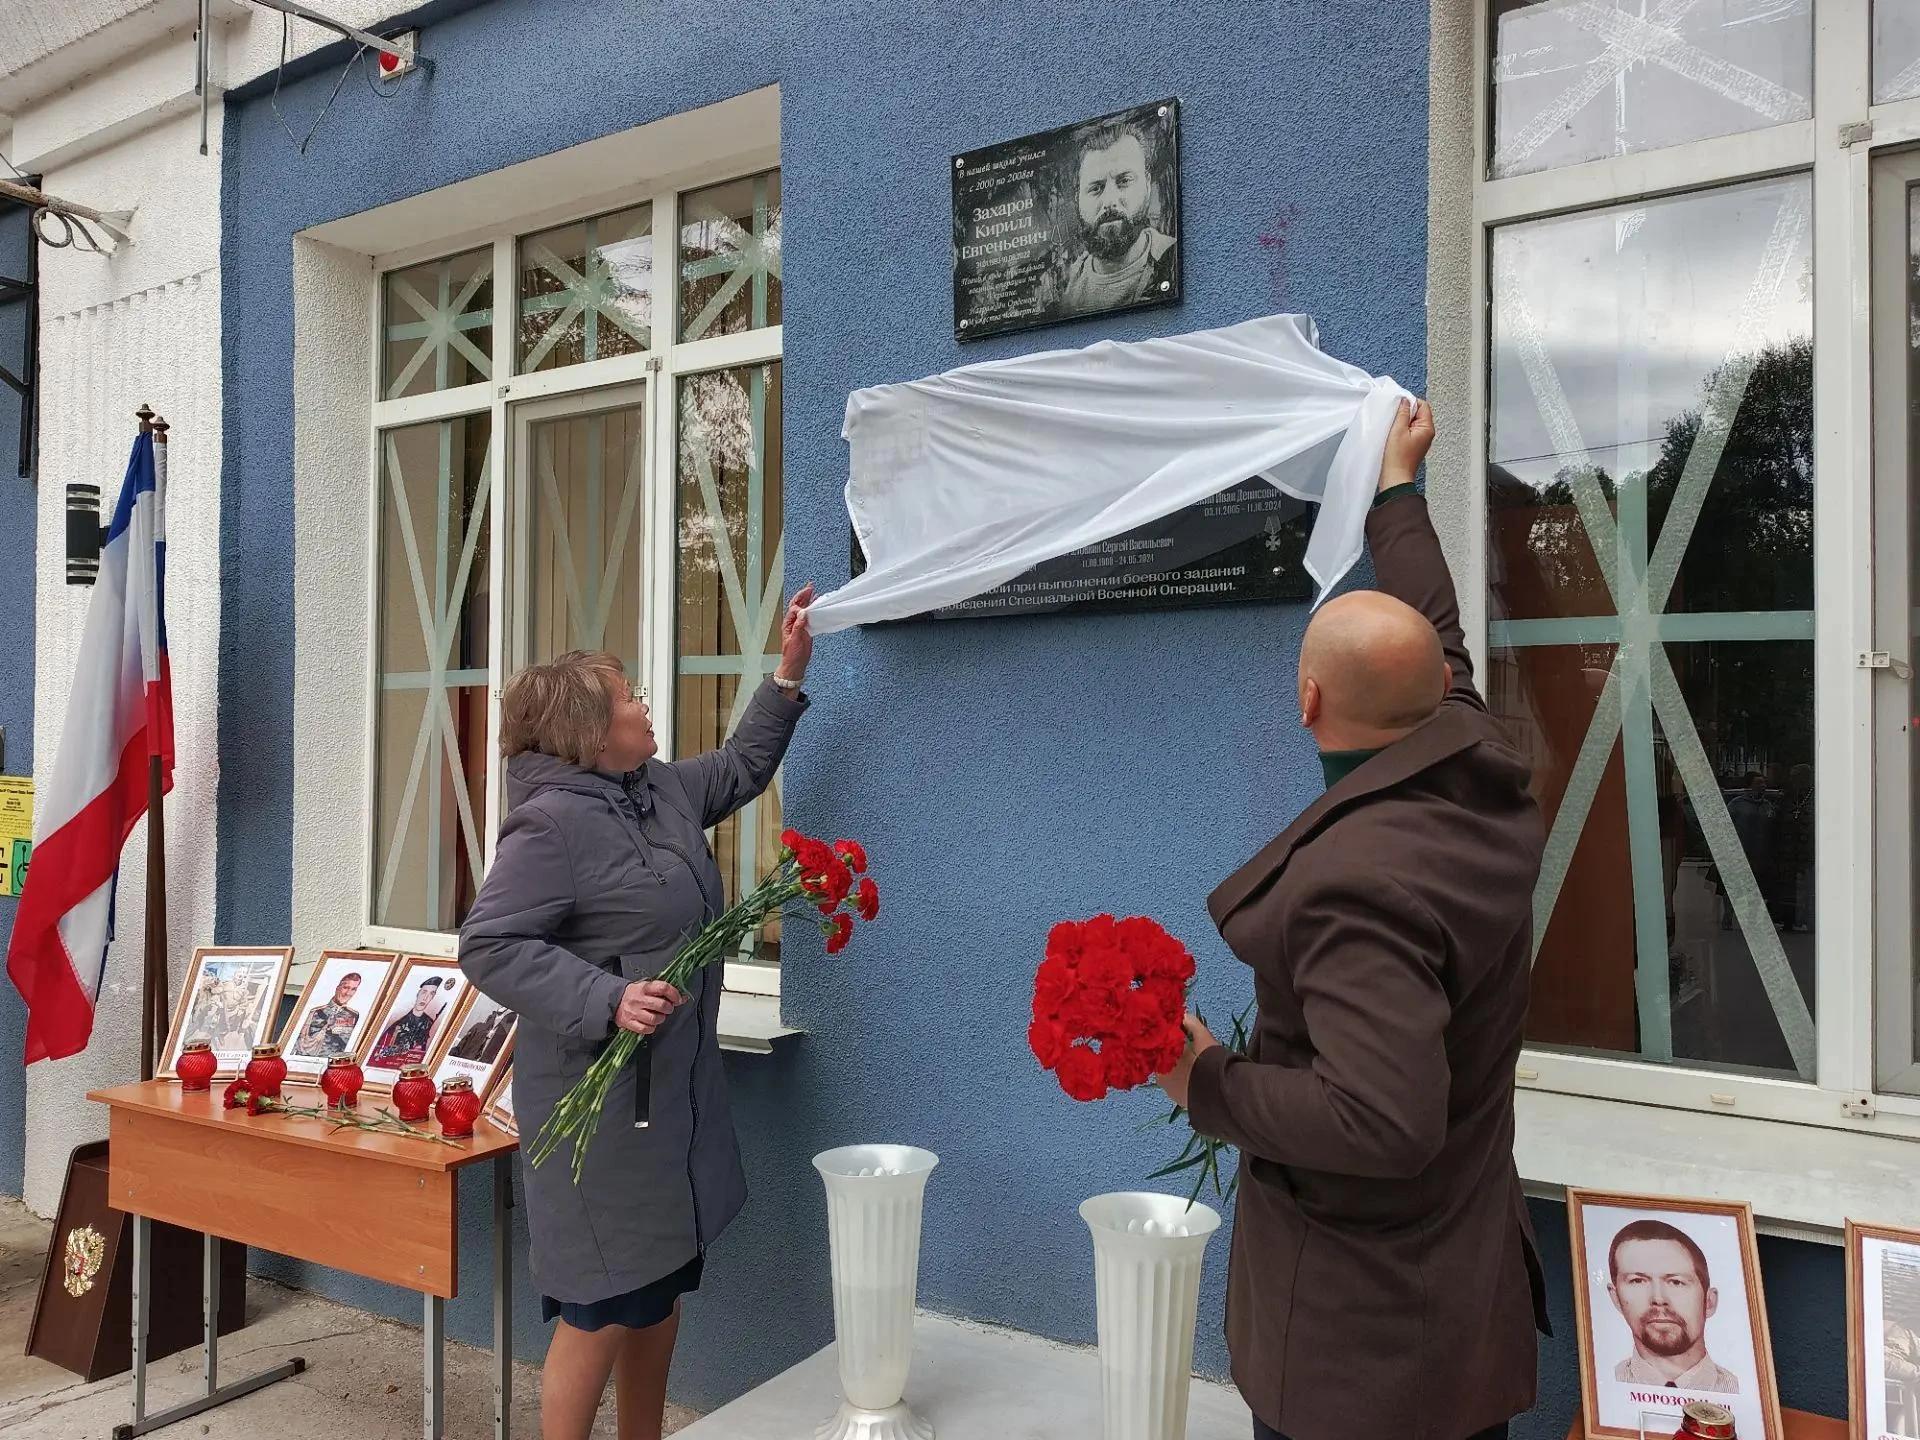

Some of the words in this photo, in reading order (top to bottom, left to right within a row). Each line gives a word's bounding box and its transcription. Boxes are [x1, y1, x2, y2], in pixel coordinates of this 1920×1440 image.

[966, 163, 990, 176] нашей
[1017, 150, 1046, 166] учился
[975, 178, 994, 191] 2000
[972, 198, 1033, 222] Захаров
[975, 216, 1032, 239] Кирилл
[962, 231, 1047, 260] Евгеньевич
[1102, 539, 1128, 554] Сергей
[1013, 583, 1036, 594] при
[1038, 576, 1120, 590] выполнении
[1123, 570, 1180, 584] боевого
[1184, 566, 1246, 581] задания
[1008, 590, 1095, 607] Специальной
[1098, 586, 1156, 600] Военной
[1160, 581, 1236, 596] Операции.
